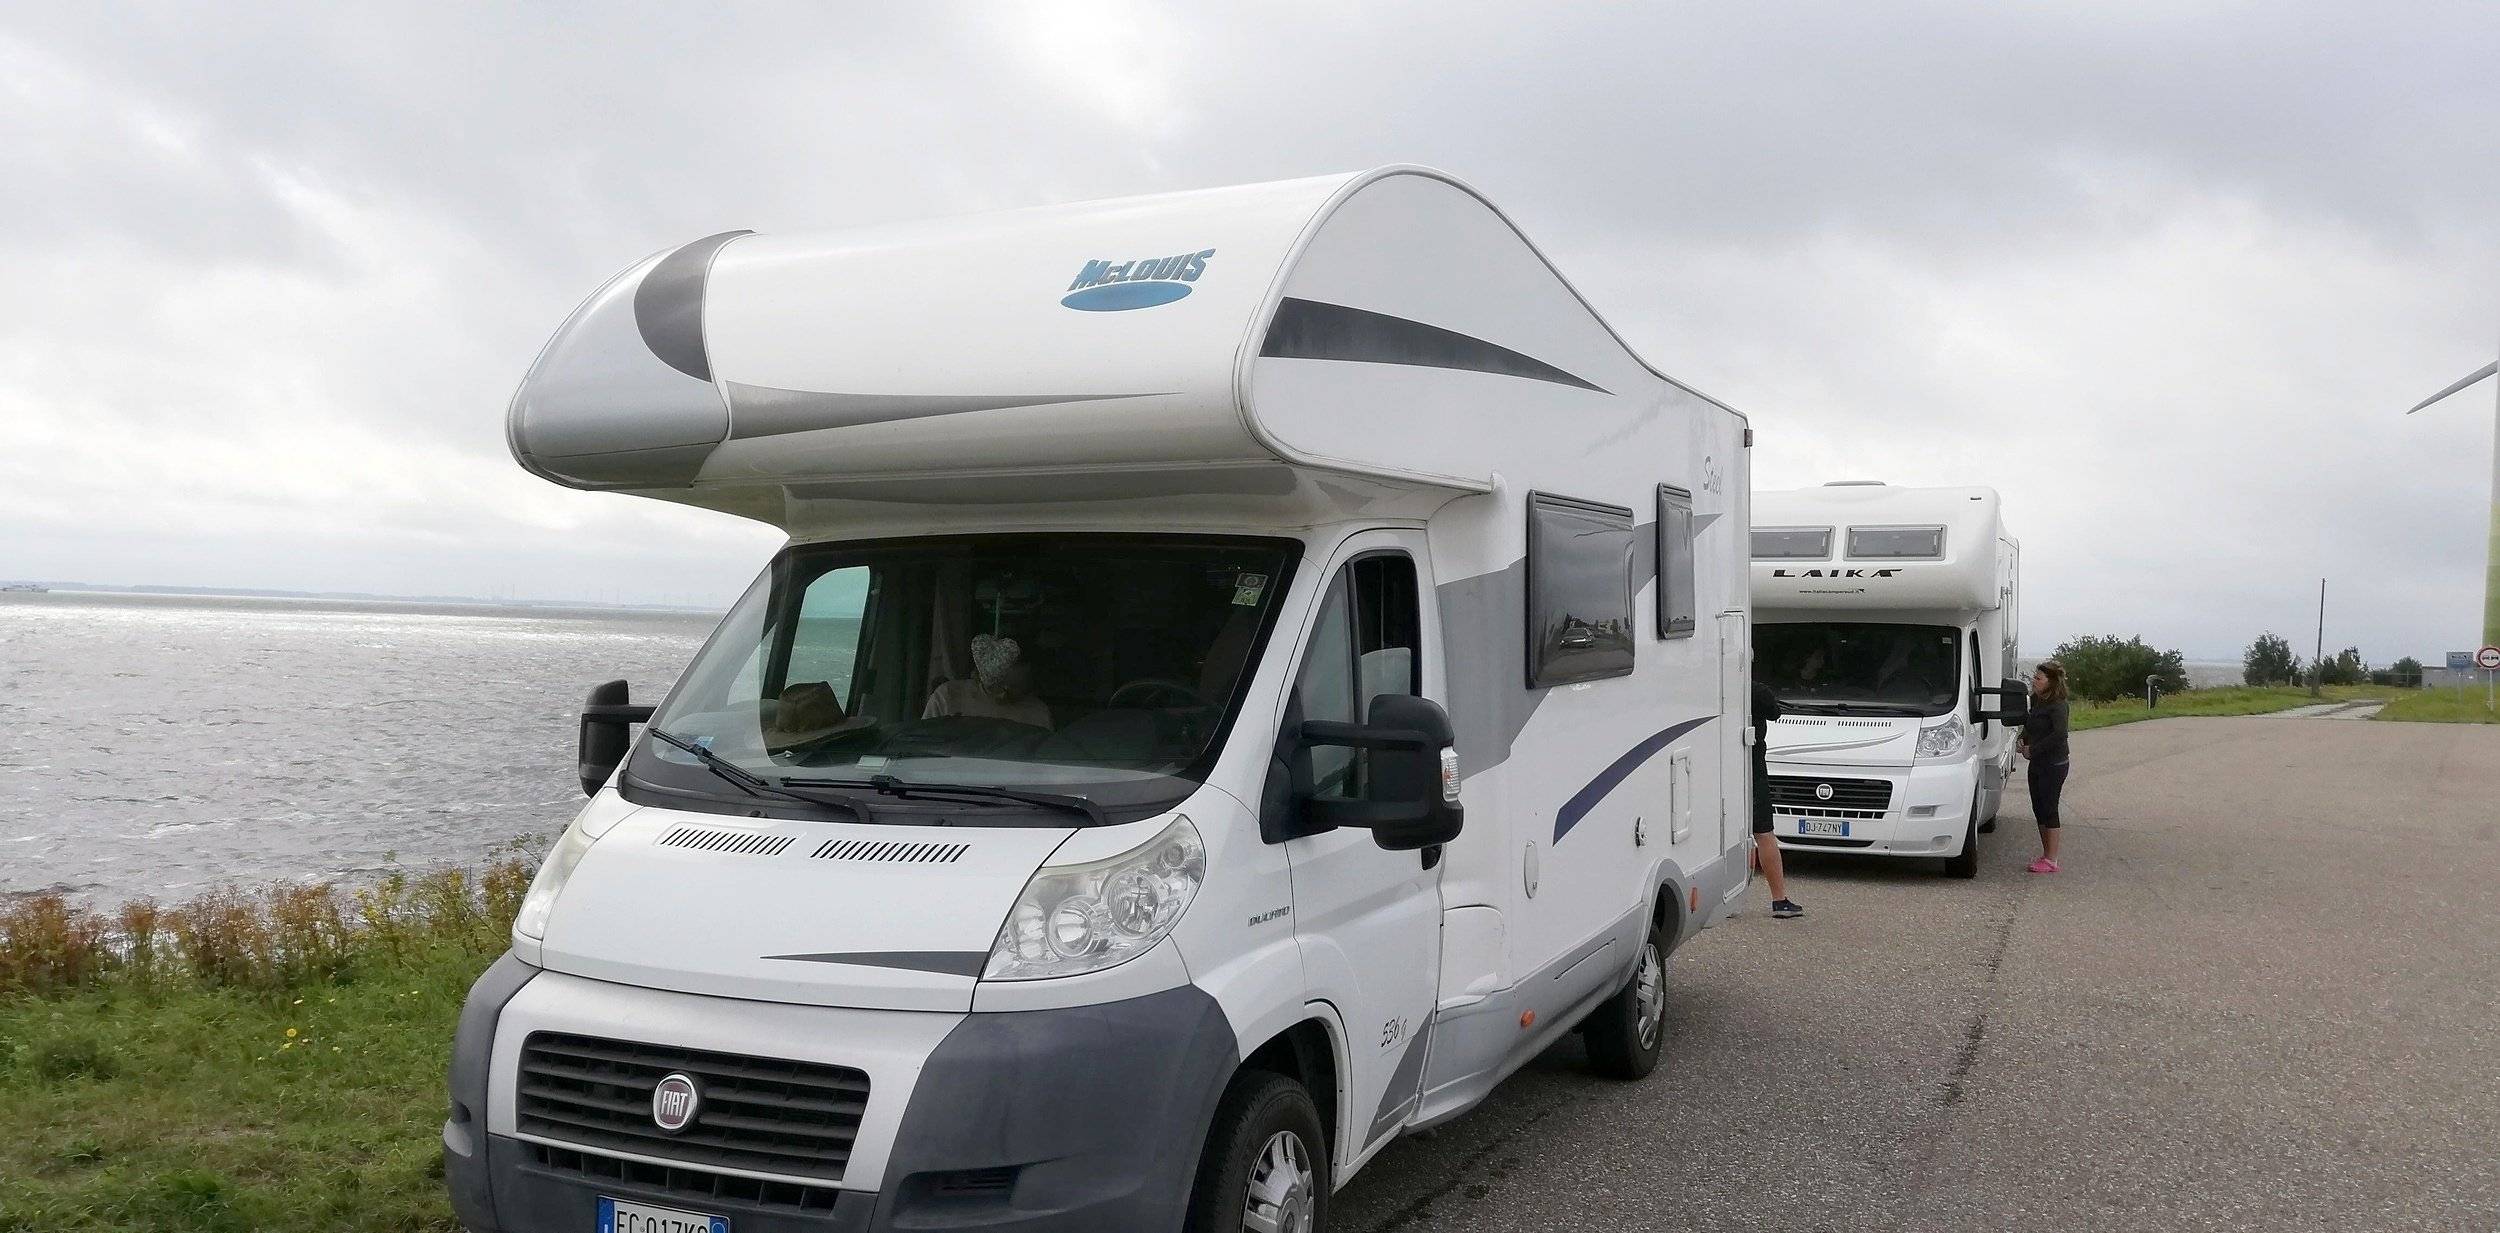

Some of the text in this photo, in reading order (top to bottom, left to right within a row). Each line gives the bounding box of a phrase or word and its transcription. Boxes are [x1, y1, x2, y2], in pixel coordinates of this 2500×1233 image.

[1067, 249, 1216, 291] McLOUIS
[1773, 568, 1903, 578] LAIKA
[661, 1090, 688, 1117] FIAT
